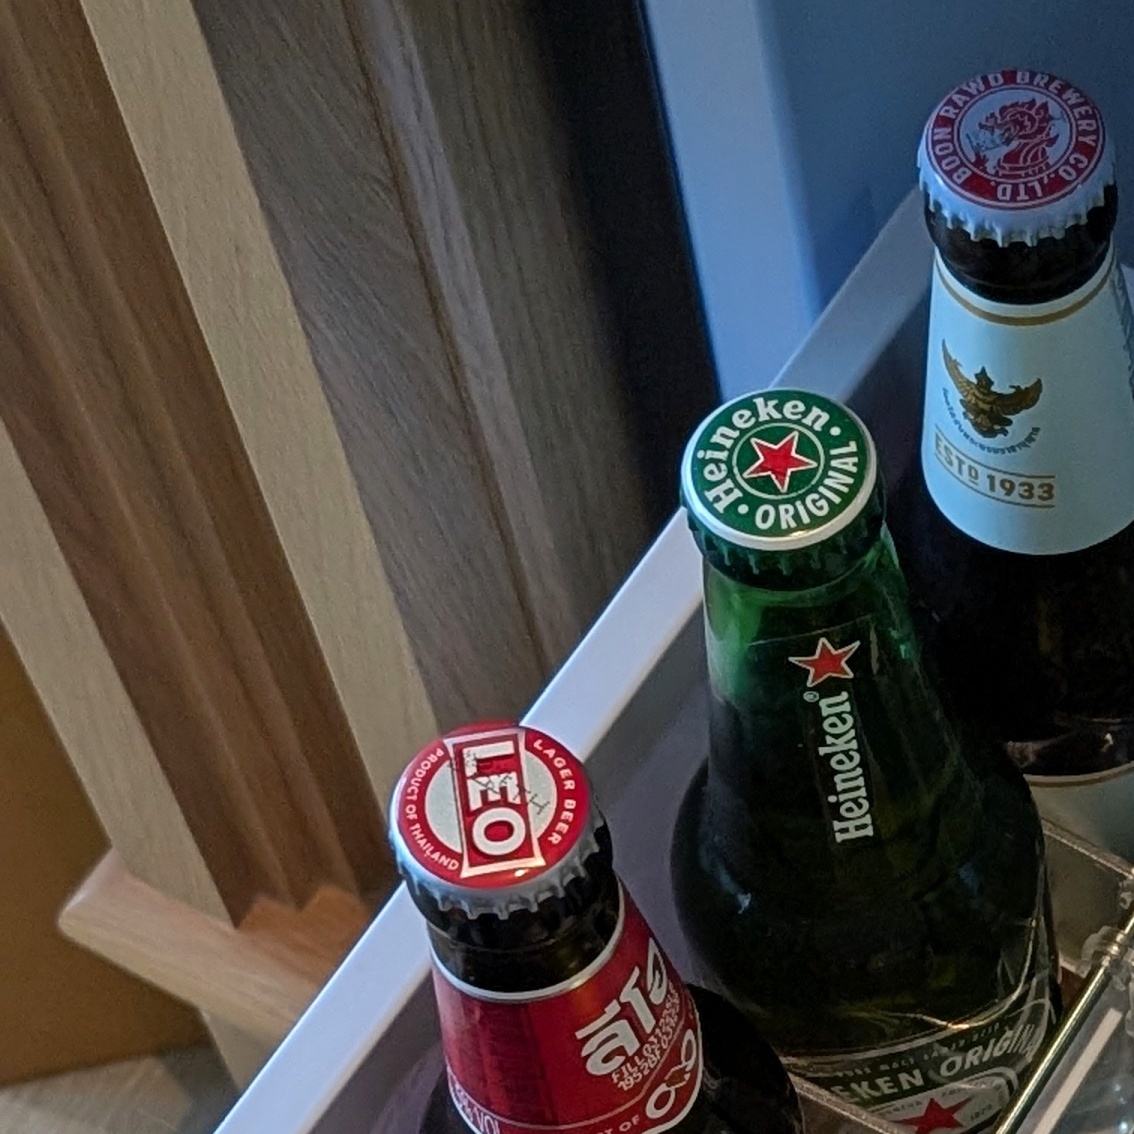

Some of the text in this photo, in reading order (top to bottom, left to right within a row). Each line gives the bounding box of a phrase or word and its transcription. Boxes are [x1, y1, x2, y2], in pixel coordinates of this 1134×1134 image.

[943, 72, 1004, 119] RAWD
[1016, 71, 1098, 148] BREWERY
[932, 127, 972, 185] BOON
[697, 396, 830, 514] Heineken
[755, 441, 858, 530] ORIGINAL
[987, 474, 1056, 501] 1933
[462, 740, 526, 856] LEO
[533, 739, 577, 844] LAGER BEER
[818, 691, 874, 843] Heineken
[405, 748, 460, 871] PRODUCT OF THAILAND
[619, 1115, 640, 1132] OF
[829, 1068, 925, 1103] EKEN
